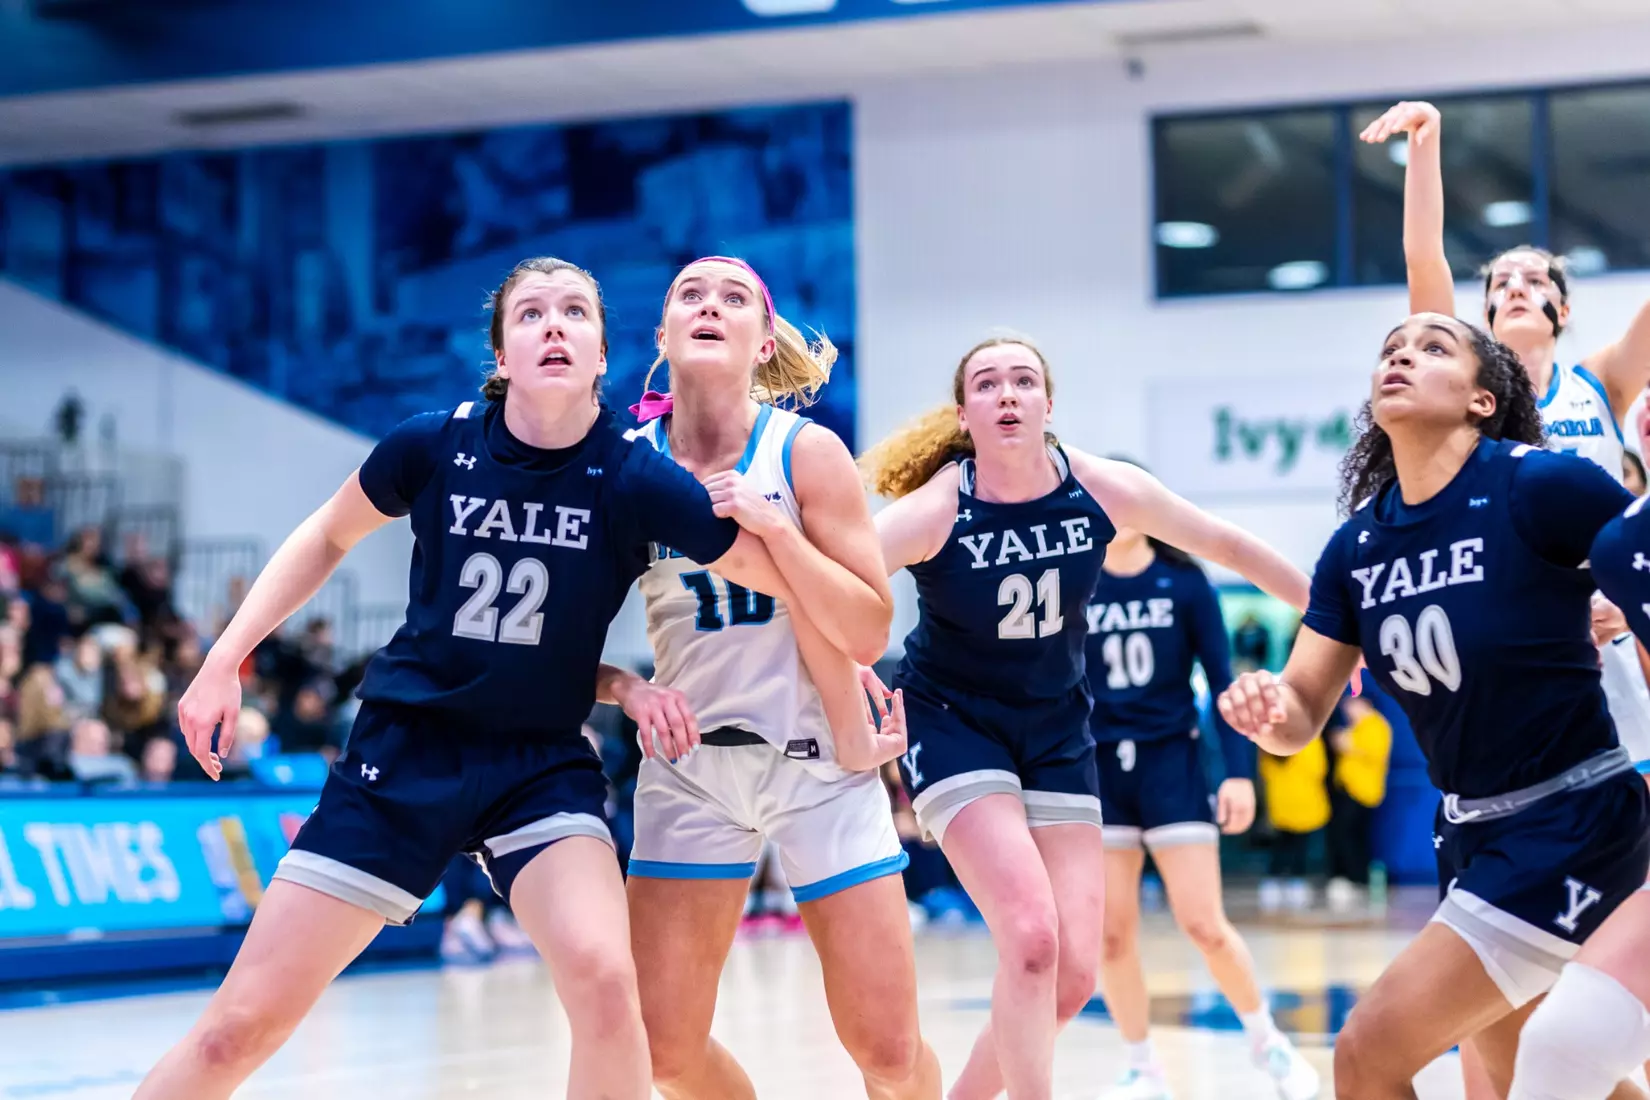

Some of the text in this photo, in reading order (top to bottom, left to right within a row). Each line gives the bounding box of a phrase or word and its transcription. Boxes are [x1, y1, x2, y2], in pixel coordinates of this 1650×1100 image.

[1212, 405, 1305, 475] Ivy
[449, 493, 591, 550] YALE
[958, 516, 1093, 569] YALE
[452, 552, 549, 646] 22
[997, 567, 1064, 639] 21
[1351, 537, 1484, 609] YALE
[1086, 598, 1174, 635] YALE
[1102, 631, 1155, 689] 10
[1379, 604, 1462, 696] 30
[902, 741, 924, 790] Y
[23, 820, 181, 906] TIMES
[1553, 875, 1603, 934] Y
